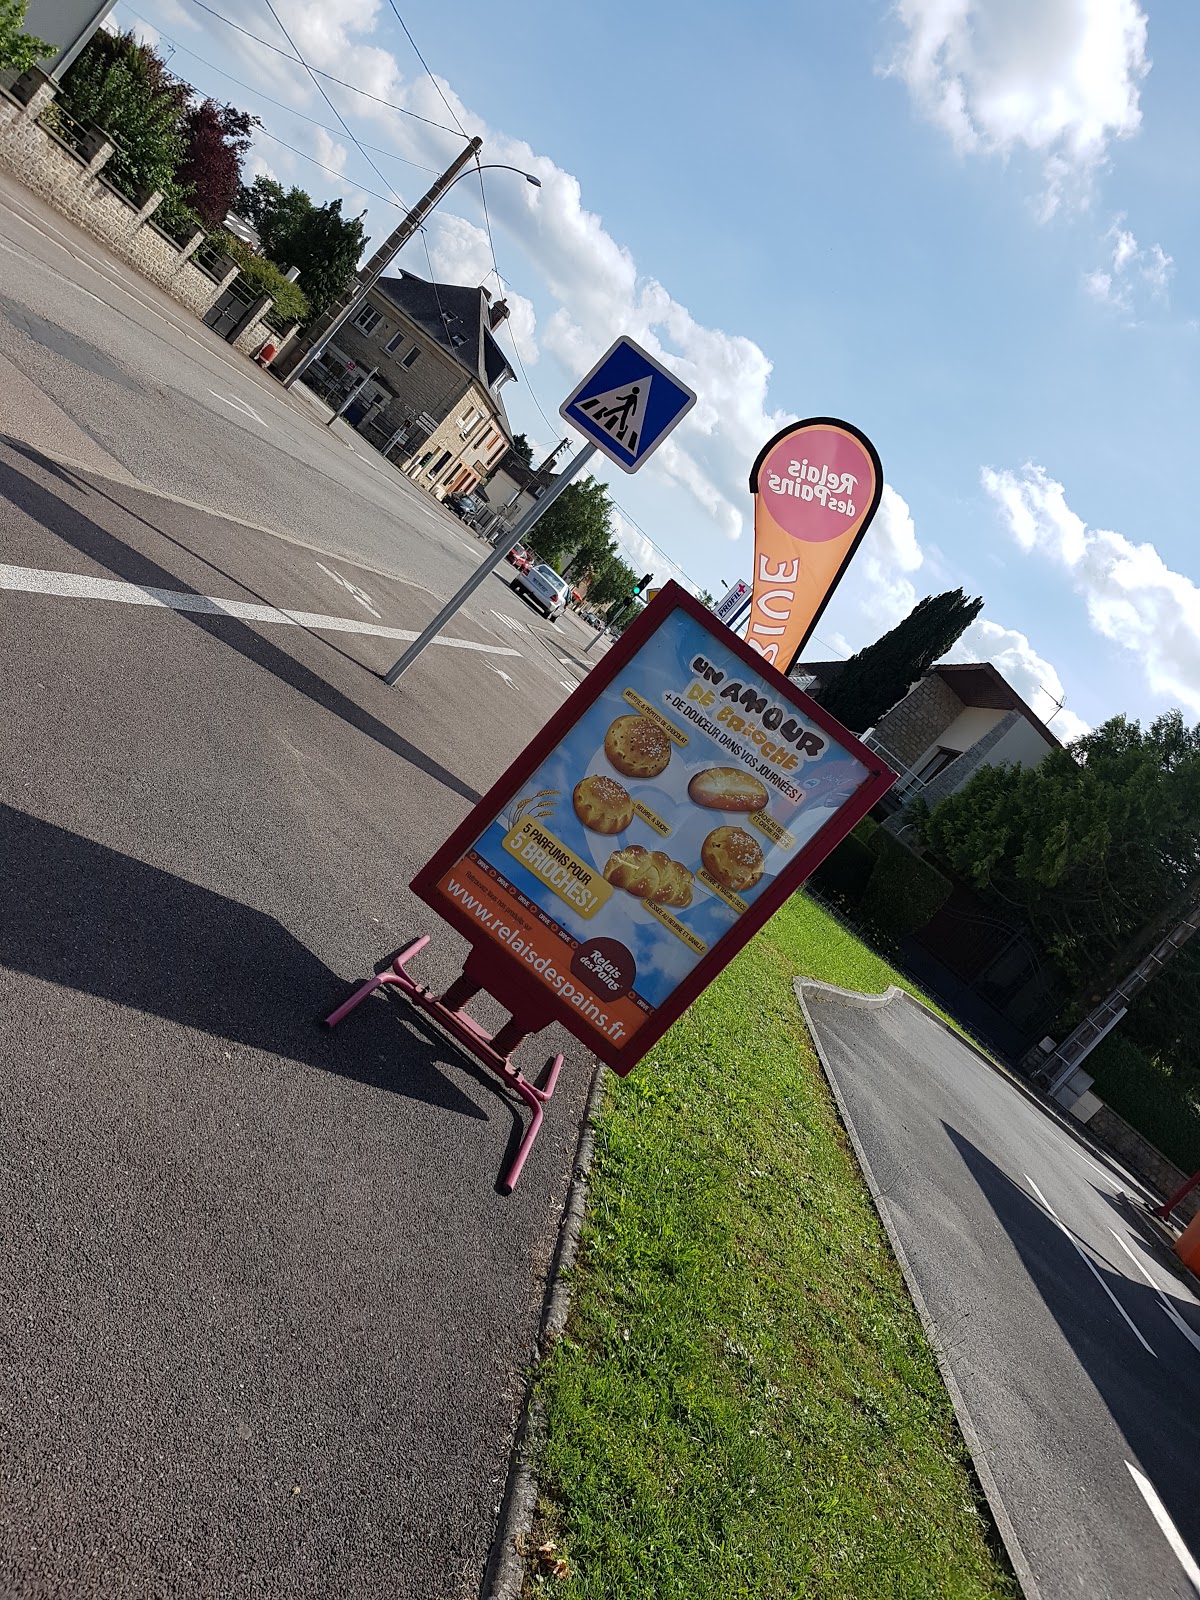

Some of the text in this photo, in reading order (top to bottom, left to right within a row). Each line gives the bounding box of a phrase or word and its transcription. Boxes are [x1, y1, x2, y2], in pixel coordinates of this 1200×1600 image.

[717, 590, 742, 617] PROFIL
[691, 655, 825, 755] UN AMOUR
[659, 719, 667, 727] DE
[665, 724, 687, 744] CHOCOLAT
[687, 682, 798, 772] DE BRIOCHE
[670, 696, 687, 711] DE
[682, 705, 722, 739] DOUCEUR
[717, 733, 743, 755] DANS
[738, 749, 759, 768] VOS
[754, 761, 799, 799] JOURNÉES
[508, 830, 528, 851] 5
[521, 822, 592, 886] 5 PARFUMS POUR
[476, 858, 571, 943] DRIVE DRIVE DRIVE DRIVE DRIVE
[660, 911, 670, 920] AU
[448, 878, 625, 1039] www.relaisdespains.fr
[578, 956, 620, 991] des Pains
[589, 950, 622, 979] Relais
[635, 998, 650, 1012] DRIVE
